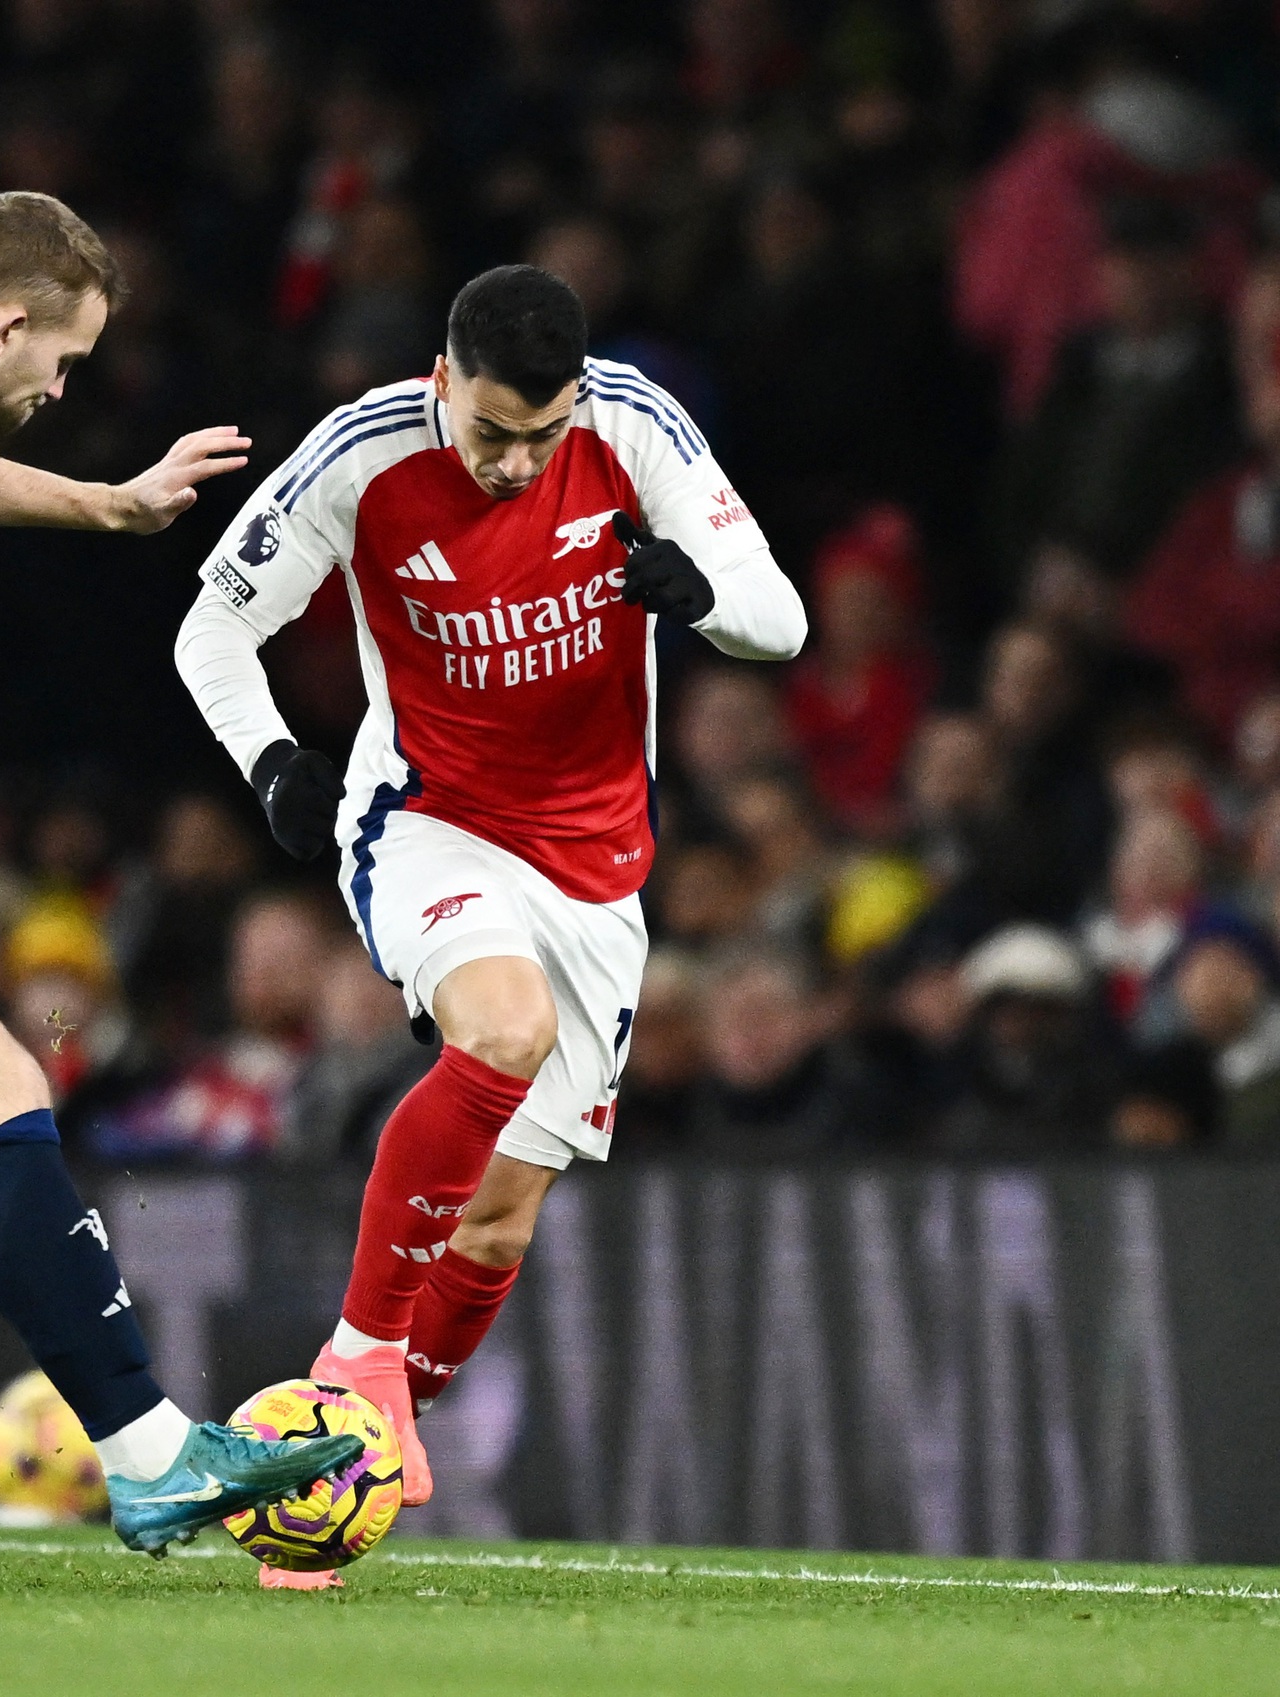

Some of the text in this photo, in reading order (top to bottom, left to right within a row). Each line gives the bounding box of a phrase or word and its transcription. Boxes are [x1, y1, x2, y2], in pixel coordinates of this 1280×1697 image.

[222, 566, 250, 597] room
[400, 566, 627, 648] Emirates
[445, 616, 605, 690] FLY BETTER
